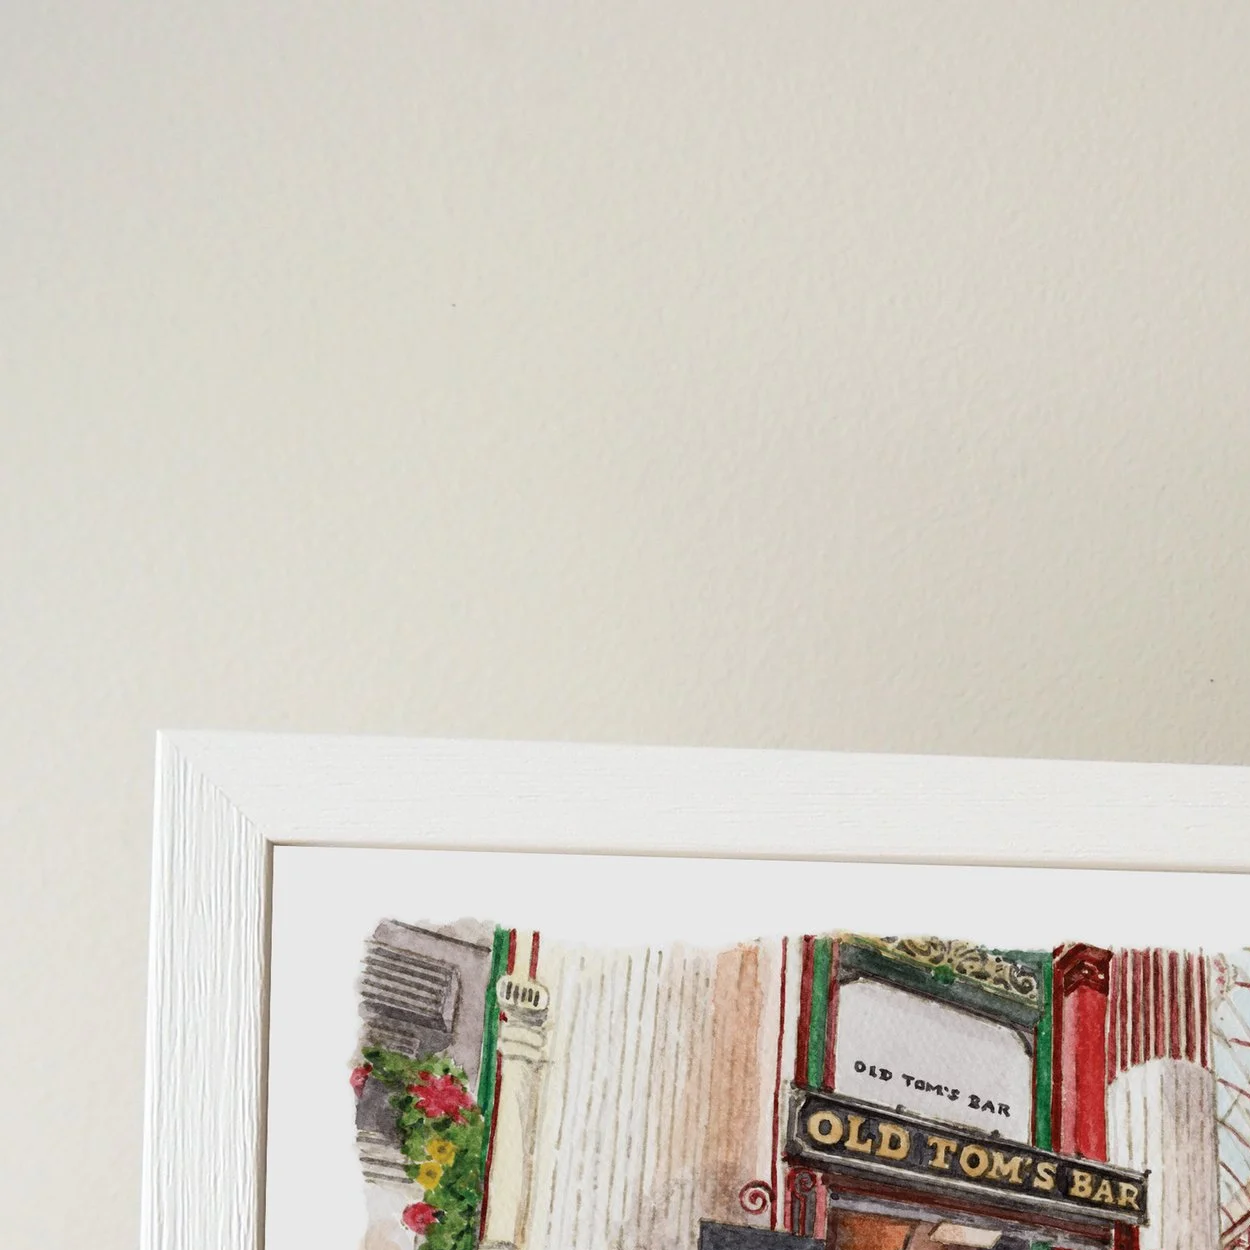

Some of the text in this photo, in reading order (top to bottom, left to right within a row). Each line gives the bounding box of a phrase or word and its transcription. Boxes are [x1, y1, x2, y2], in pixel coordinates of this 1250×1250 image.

[854, 1060, 1011, 1117] OLD TOM'S BAR
[807, 1110, 1140, 1211] OLD TOM'S BAR
